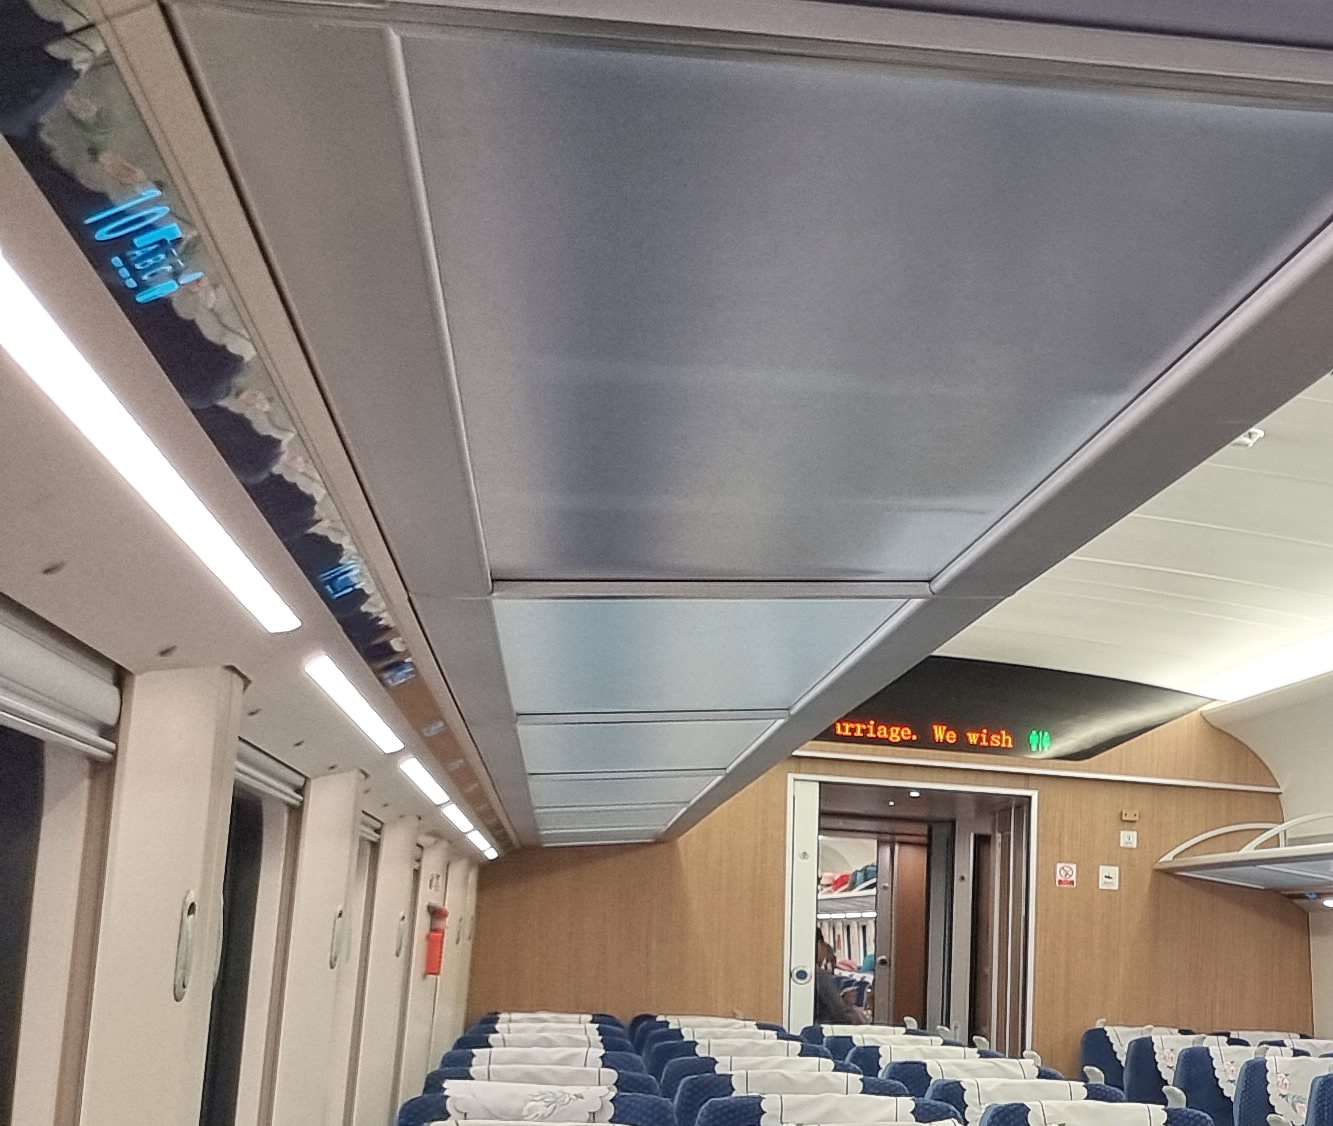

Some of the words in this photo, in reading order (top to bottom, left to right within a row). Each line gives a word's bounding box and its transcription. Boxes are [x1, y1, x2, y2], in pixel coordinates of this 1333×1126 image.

[83, 188, 171, 241] 10
[932, 724, 957, 743] We
[966, 728, 1014, 748] wish
